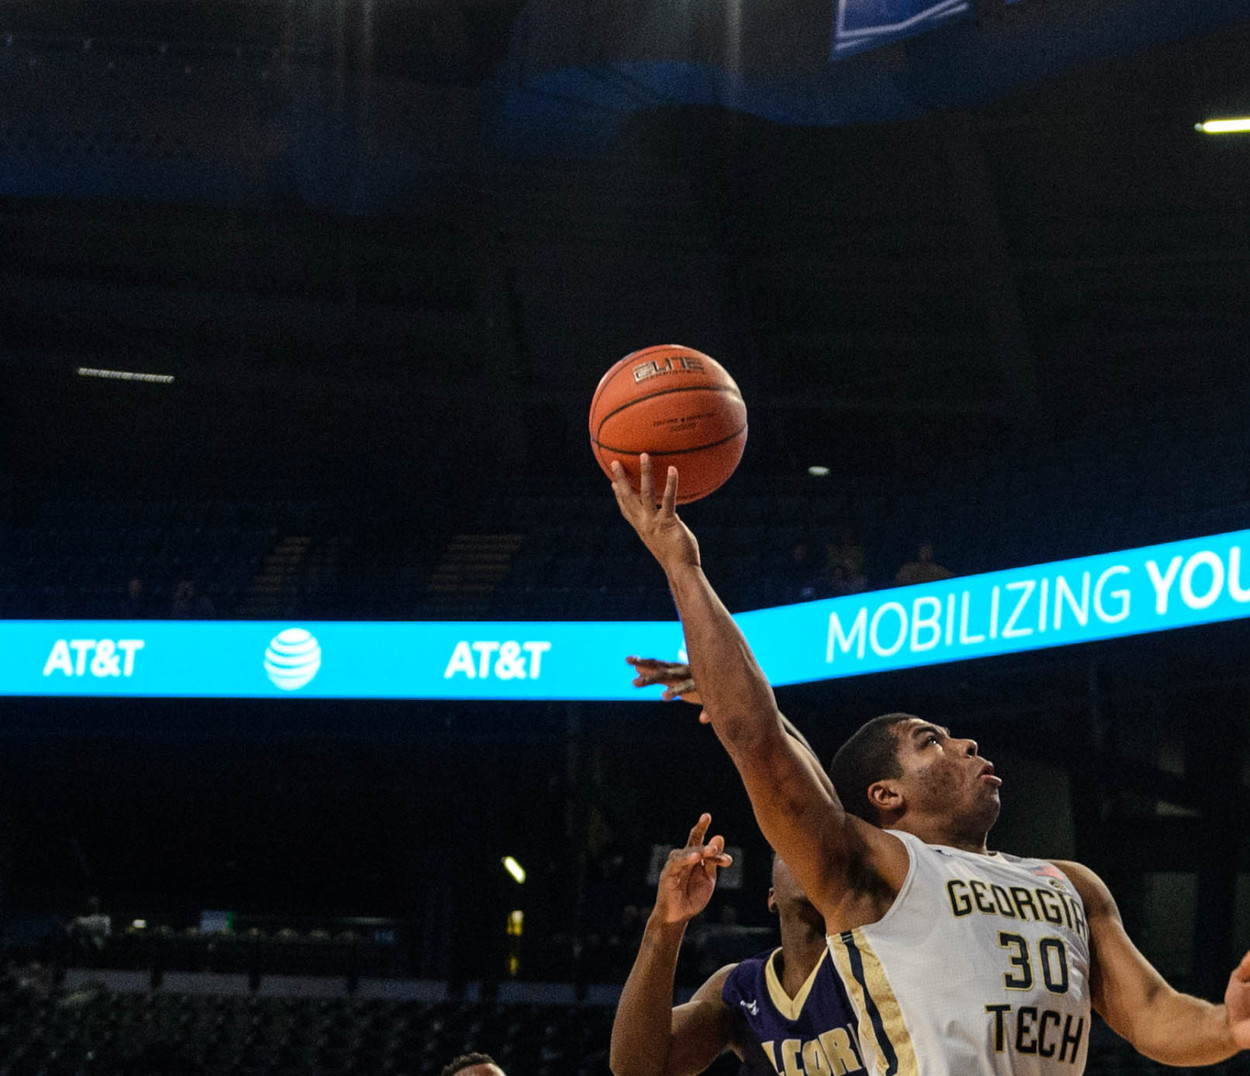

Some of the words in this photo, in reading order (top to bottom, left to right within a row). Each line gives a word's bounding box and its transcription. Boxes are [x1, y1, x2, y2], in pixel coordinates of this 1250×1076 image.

[825, 565, 1132, 664] MOBILIZING
[42, 638, 145, 677] AT&T
[443, 640, 551, 680] AT&T
[945, 878, 1088, 942] GEORGIA
[997, 930, 1074, 995] 30
[984, 1003, 1084, 1065] TECH
